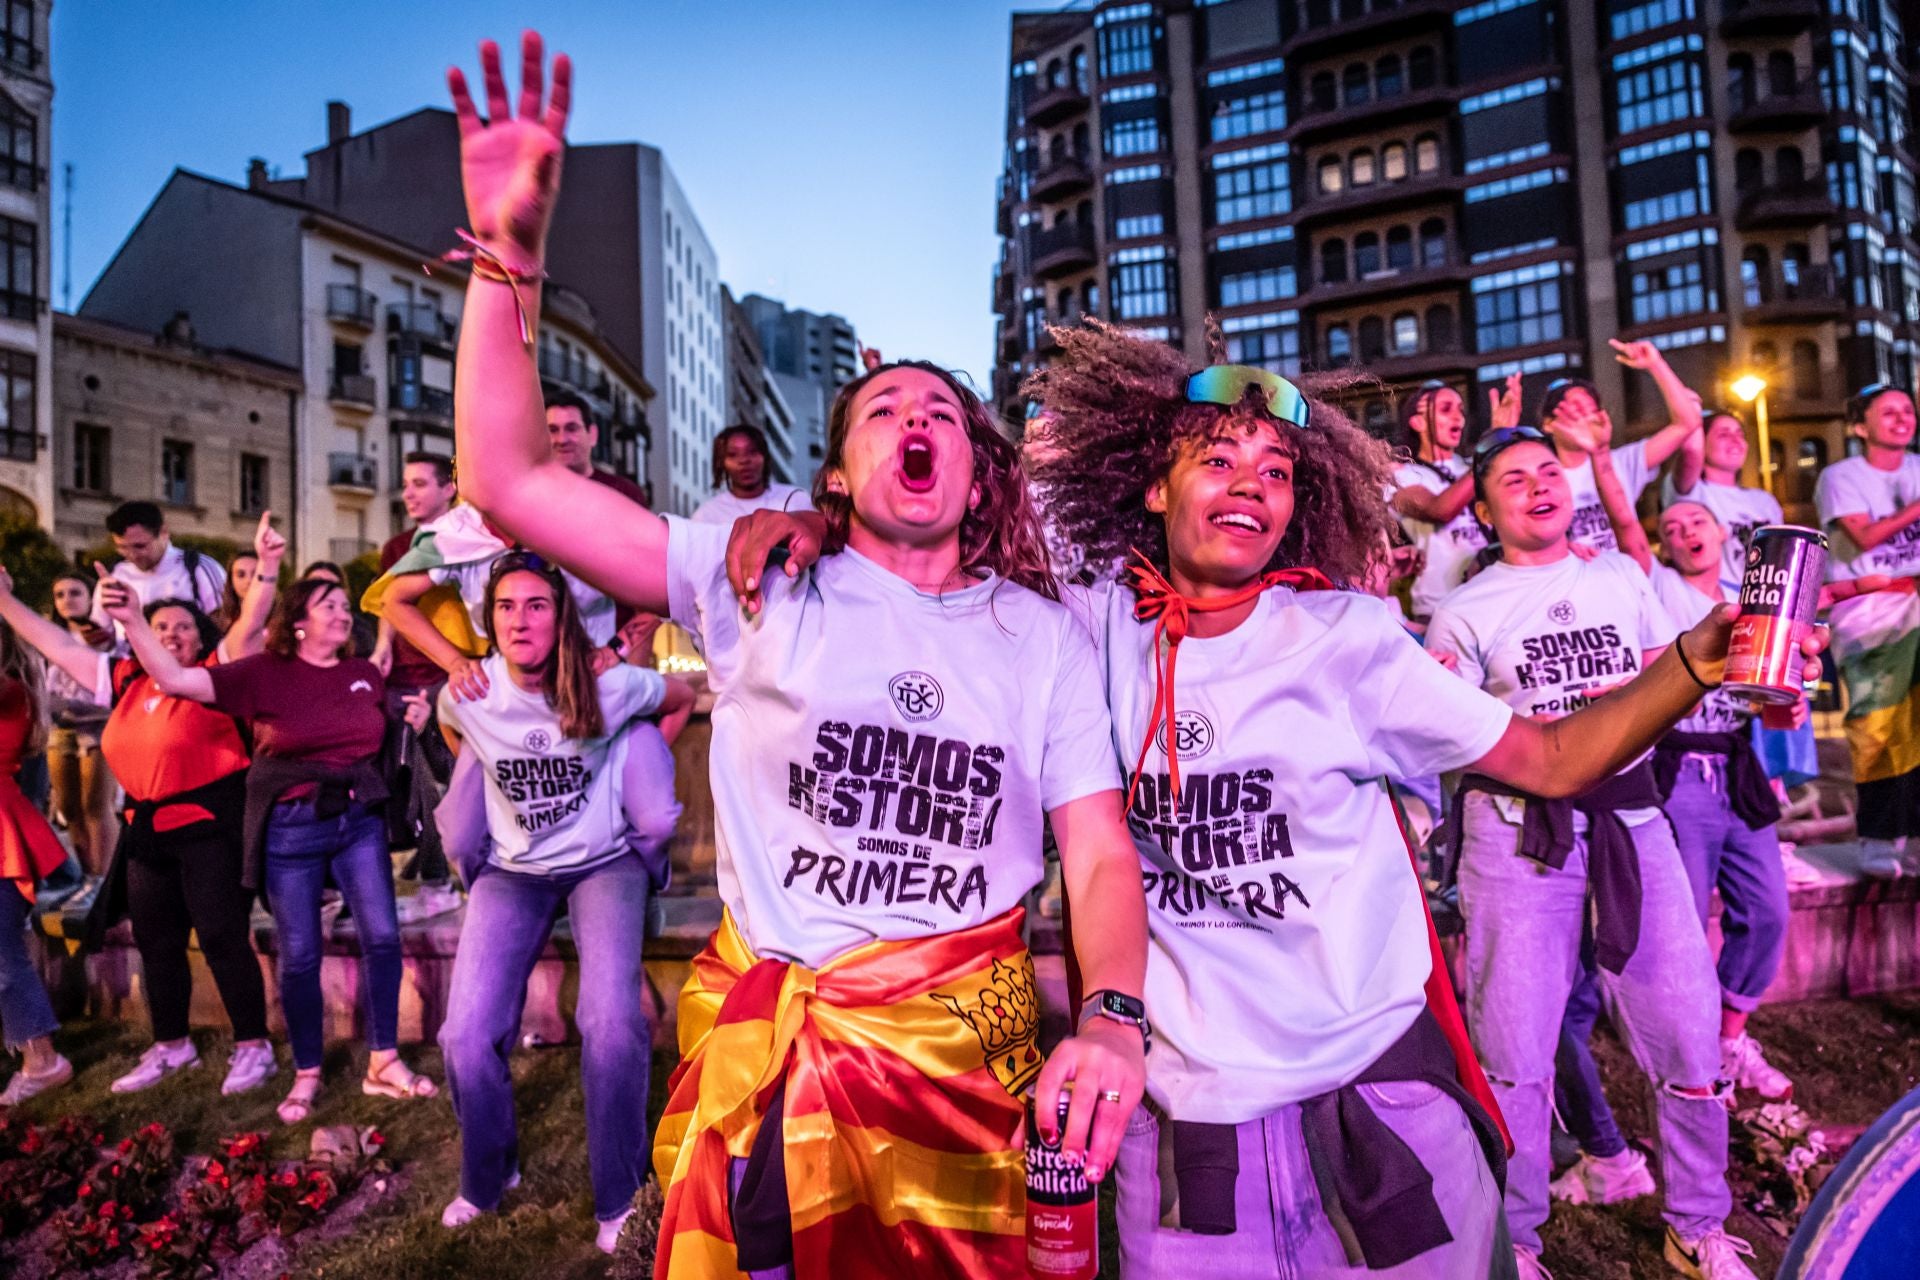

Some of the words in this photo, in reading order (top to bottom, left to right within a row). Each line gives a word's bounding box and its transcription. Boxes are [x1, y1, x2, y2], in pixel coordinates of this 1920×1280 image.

[1740, 584, 1781, 606] licia
[1745, 564, 1789, 586] rella
[1522, 624, 1622, 662] SOMOS
[1515, 647, 1638, 691] HISTORIA
[496, 755, 584, 781] SOMOS
[812, 719, 1005, 797] SOMOS
[788, 762, 1003, 851] HISTORIA
[1128, 768, 1274, 824] OMOS
[857, 837, 908, 856] SOMOS
[912, 844, 933, 860] DE
[1128, 814, 1294, 873] STORIA
[783, 845, 989, 913] PRIMERA
[1211, 874, 1231, 893] DE
